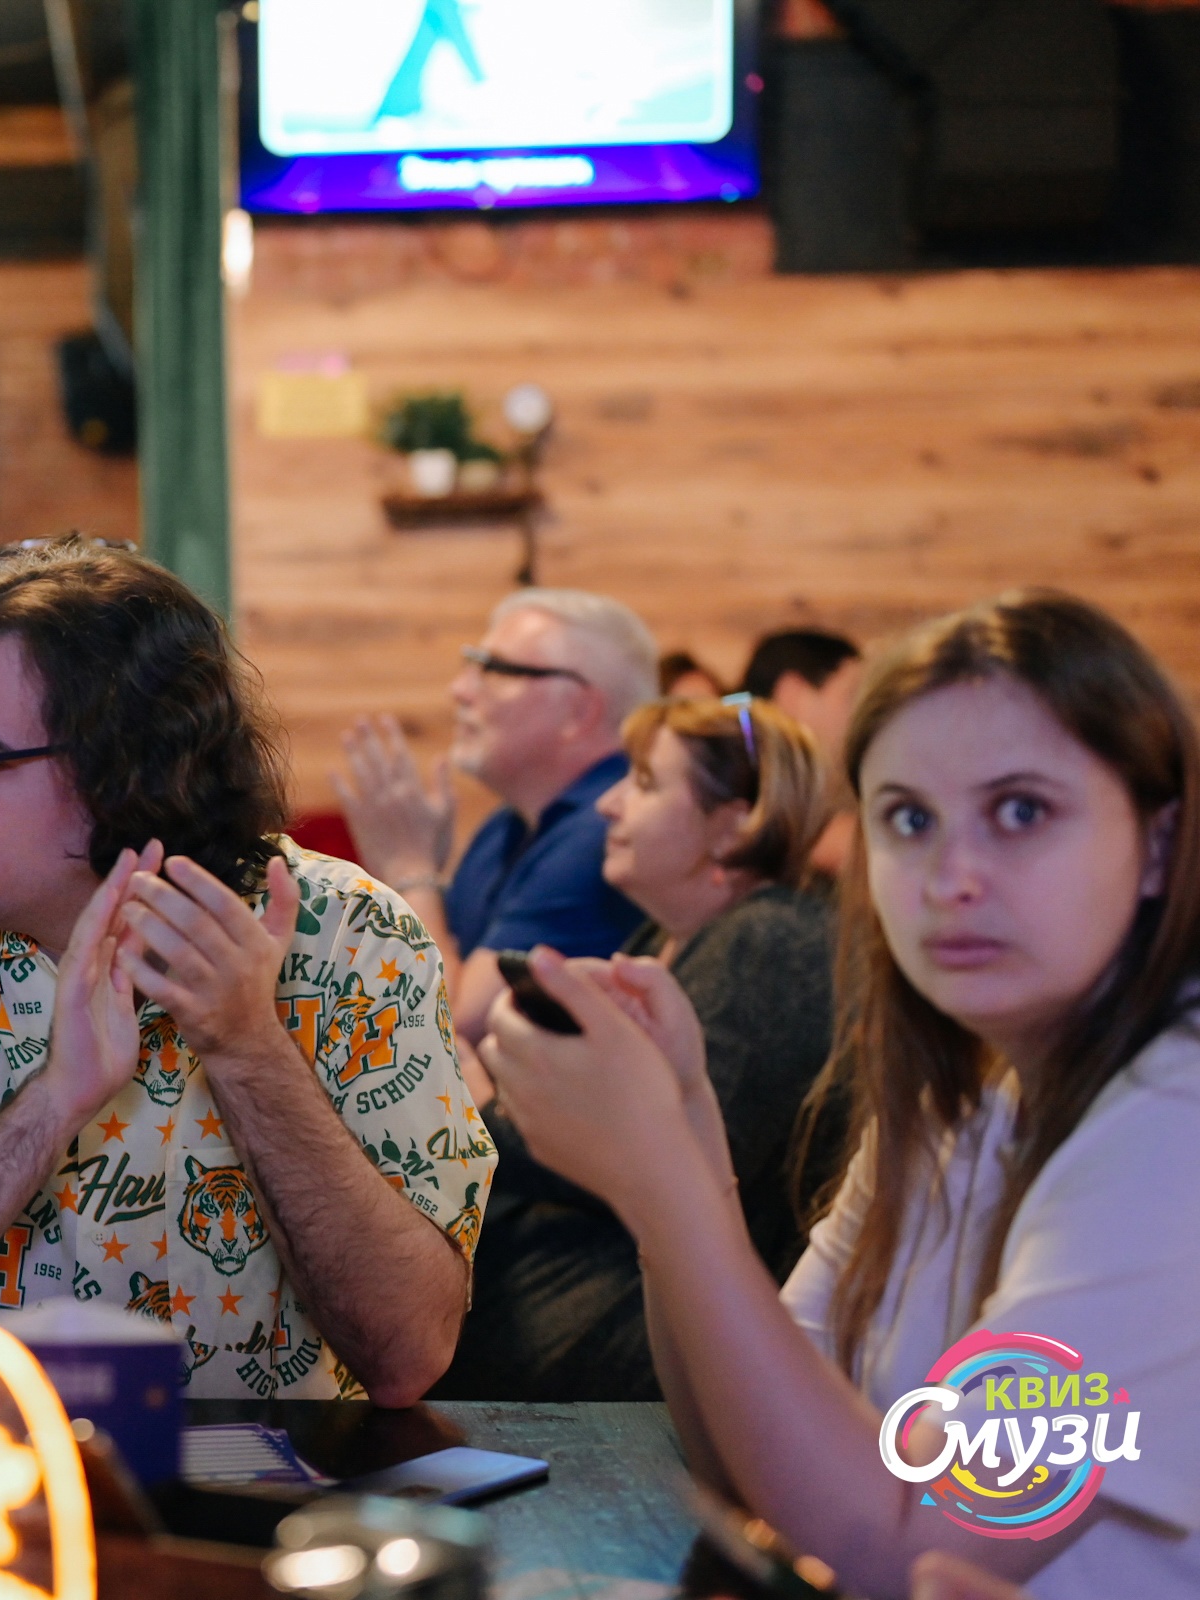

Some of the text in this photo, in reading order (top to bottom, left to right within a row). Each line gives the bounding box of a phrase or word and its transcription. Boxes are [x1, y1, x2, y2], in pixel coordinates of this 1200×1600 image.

[13, 1001, 42, 1015] 1952
[4, 1036, 48, 1070] HOOL
[356, 1053, 432, 1114] SCHOOL
[409, 1192, 438, 1217] 1952
[34, 1262, 62, 1280] 1952
[275, 1336, 322, 1386] HOOL
